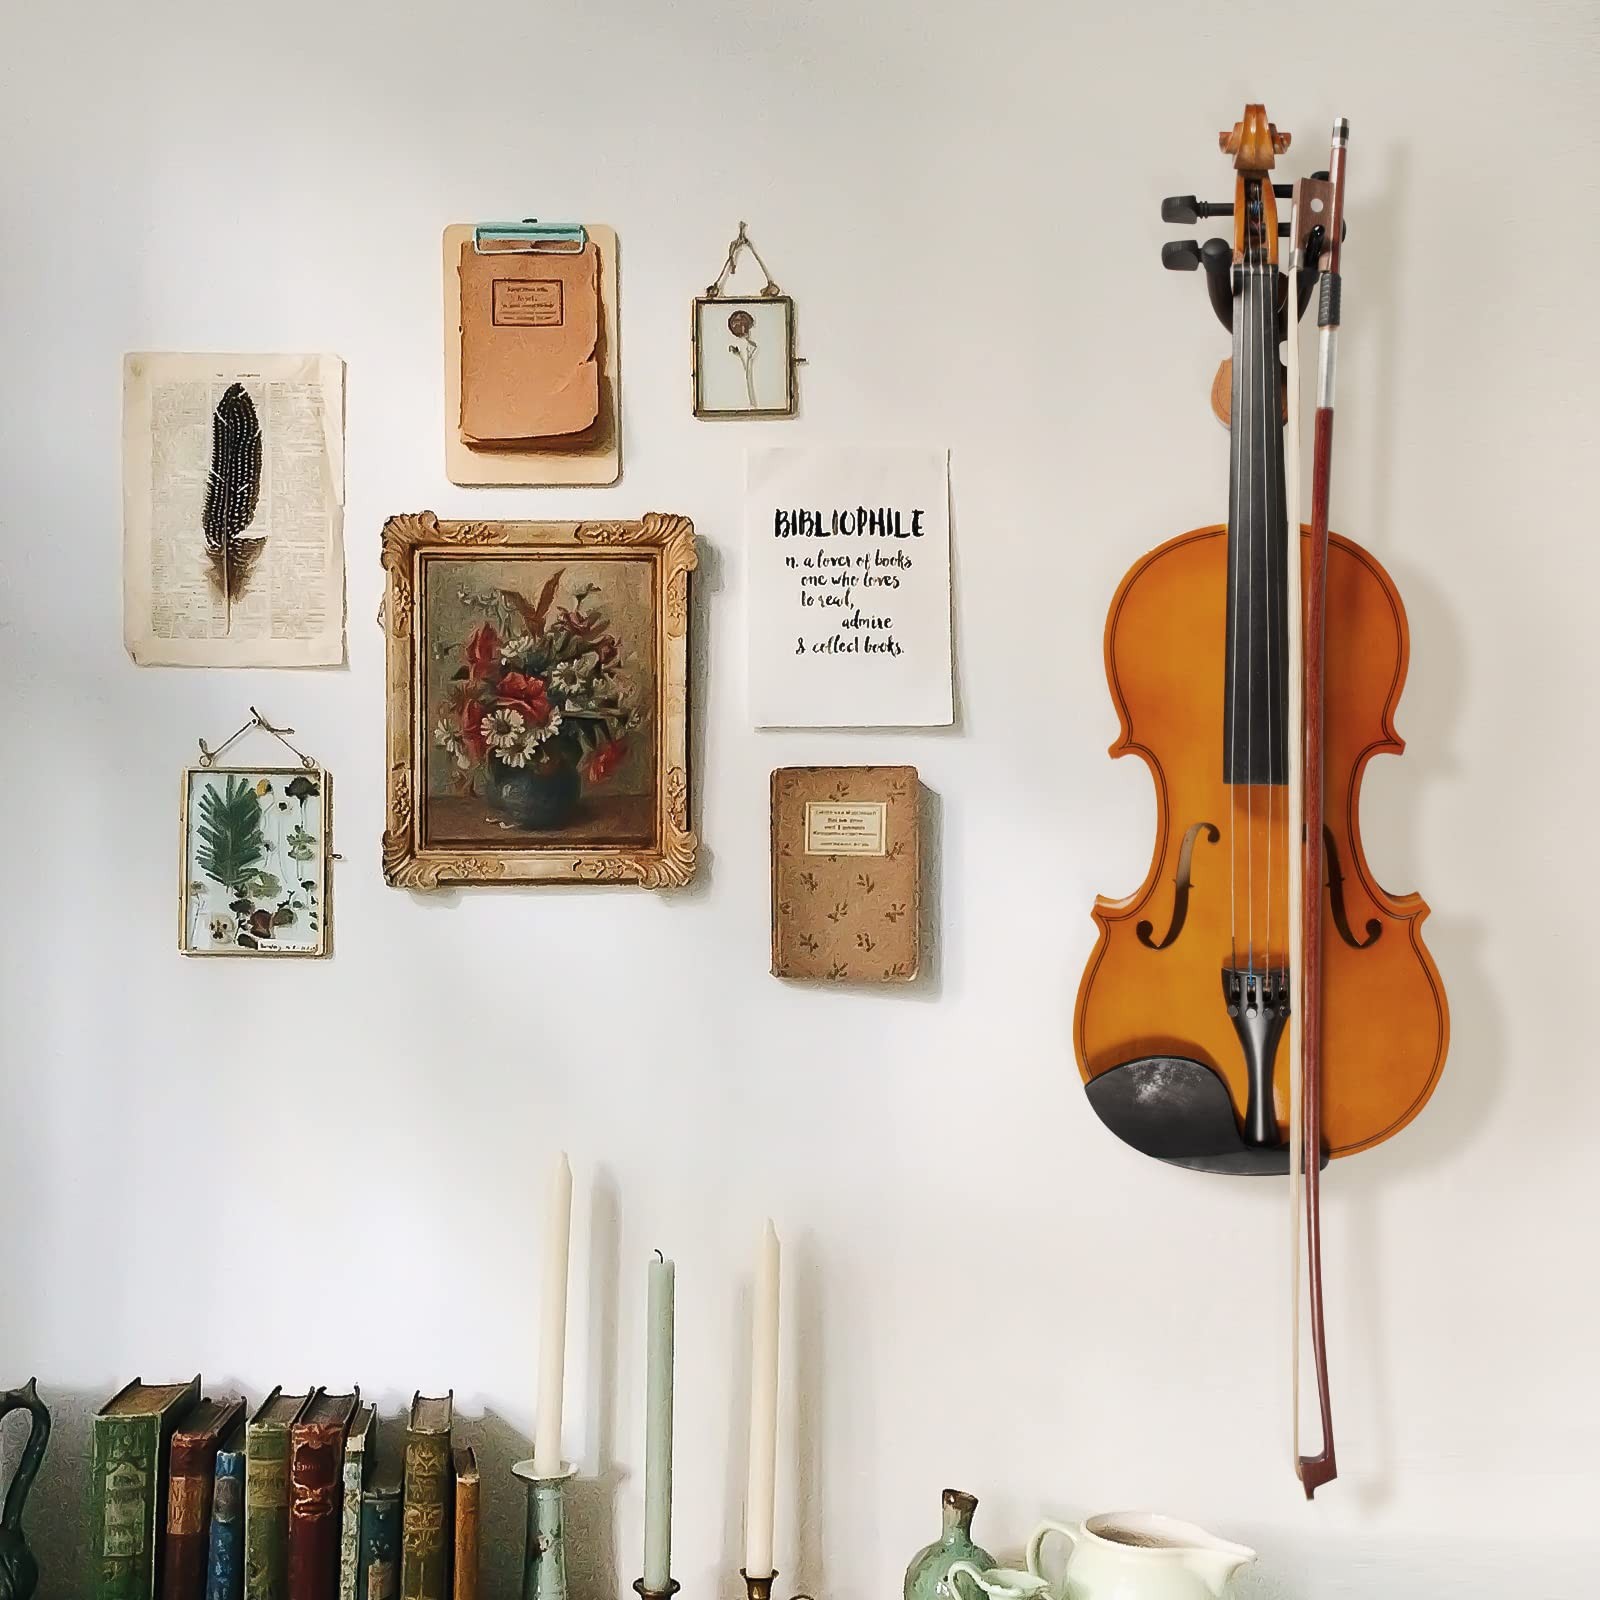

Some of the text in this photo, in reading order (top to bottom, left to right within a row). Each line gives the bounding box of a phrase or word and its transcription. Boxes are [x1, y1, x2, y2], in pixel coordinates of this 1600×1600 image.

[774, 506, 924, 538] BIBLIOPHILE
[785, 549, 912, 576] n. a lover of books
[801, 571, 899, 589] one who loves
[801, 588, 854, 610] to read,
[841, 608, 892, 629] admire
[796, 634, 905, 658] & collect books.
